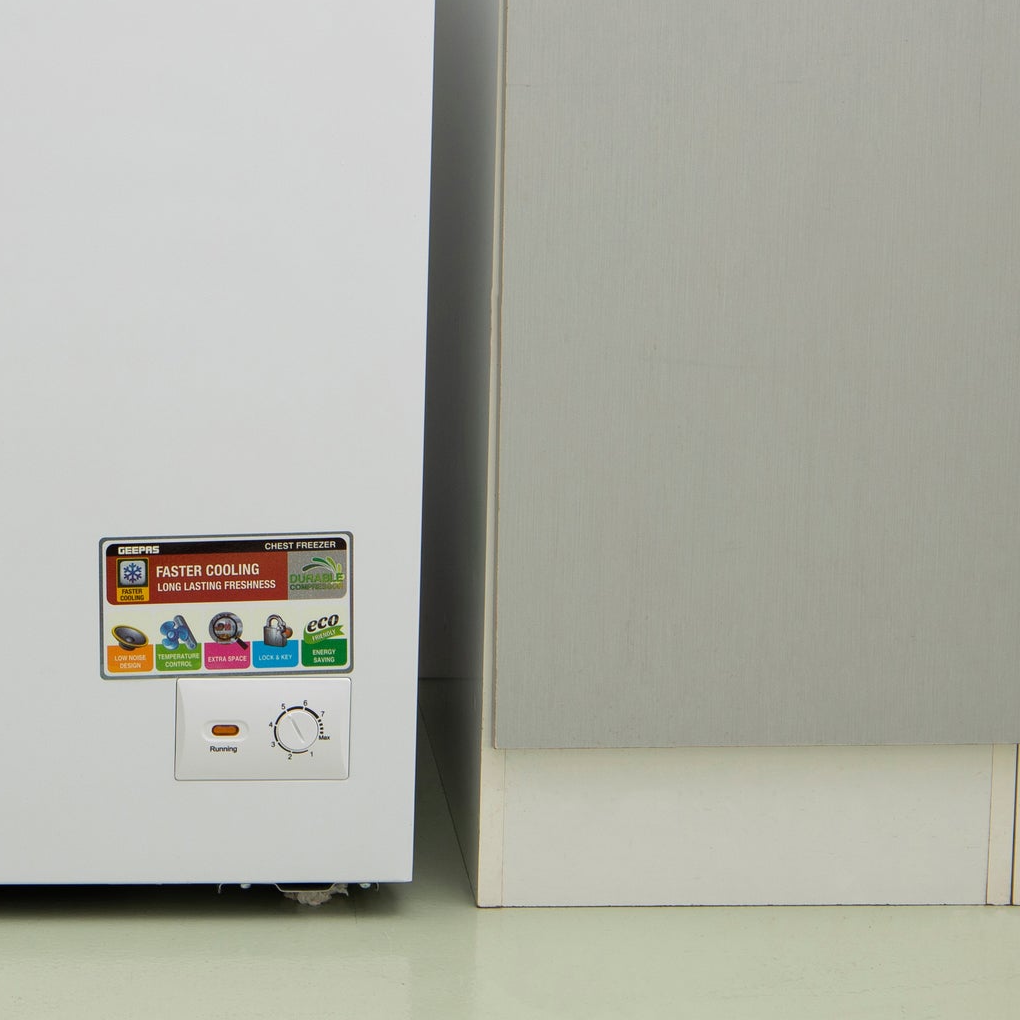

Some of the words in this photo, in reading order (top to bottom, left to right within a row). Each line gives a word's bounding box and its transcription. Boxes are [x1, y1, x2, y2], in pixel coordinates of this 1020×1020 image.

[264, 542, 294, 550] CHEST
[296, 541, 336, 549] FREEZER
[118, 546, 160, 555] GEEPAS
[156, 564, 203, 578] FASTER
[206, 563, 260, 577] COOLING
[157, 582, 182, 592] LONG
[184, 580, 222, 591] LASTING
[224, 579, 276, 590] FRESHNESS
[307, 614, 340, 632] eco
[157, 652, 200, 660] TEMPERATURE
[312, 648, 336, 656] ENERGY
[114, 654, 128, 662] LOW
[208, 655, 227, 663] EXTRA
[228, 654, 247, 662] SPACE
[313, 656, 335, 664] SAVING
[209, 745, 238, 753] Running
